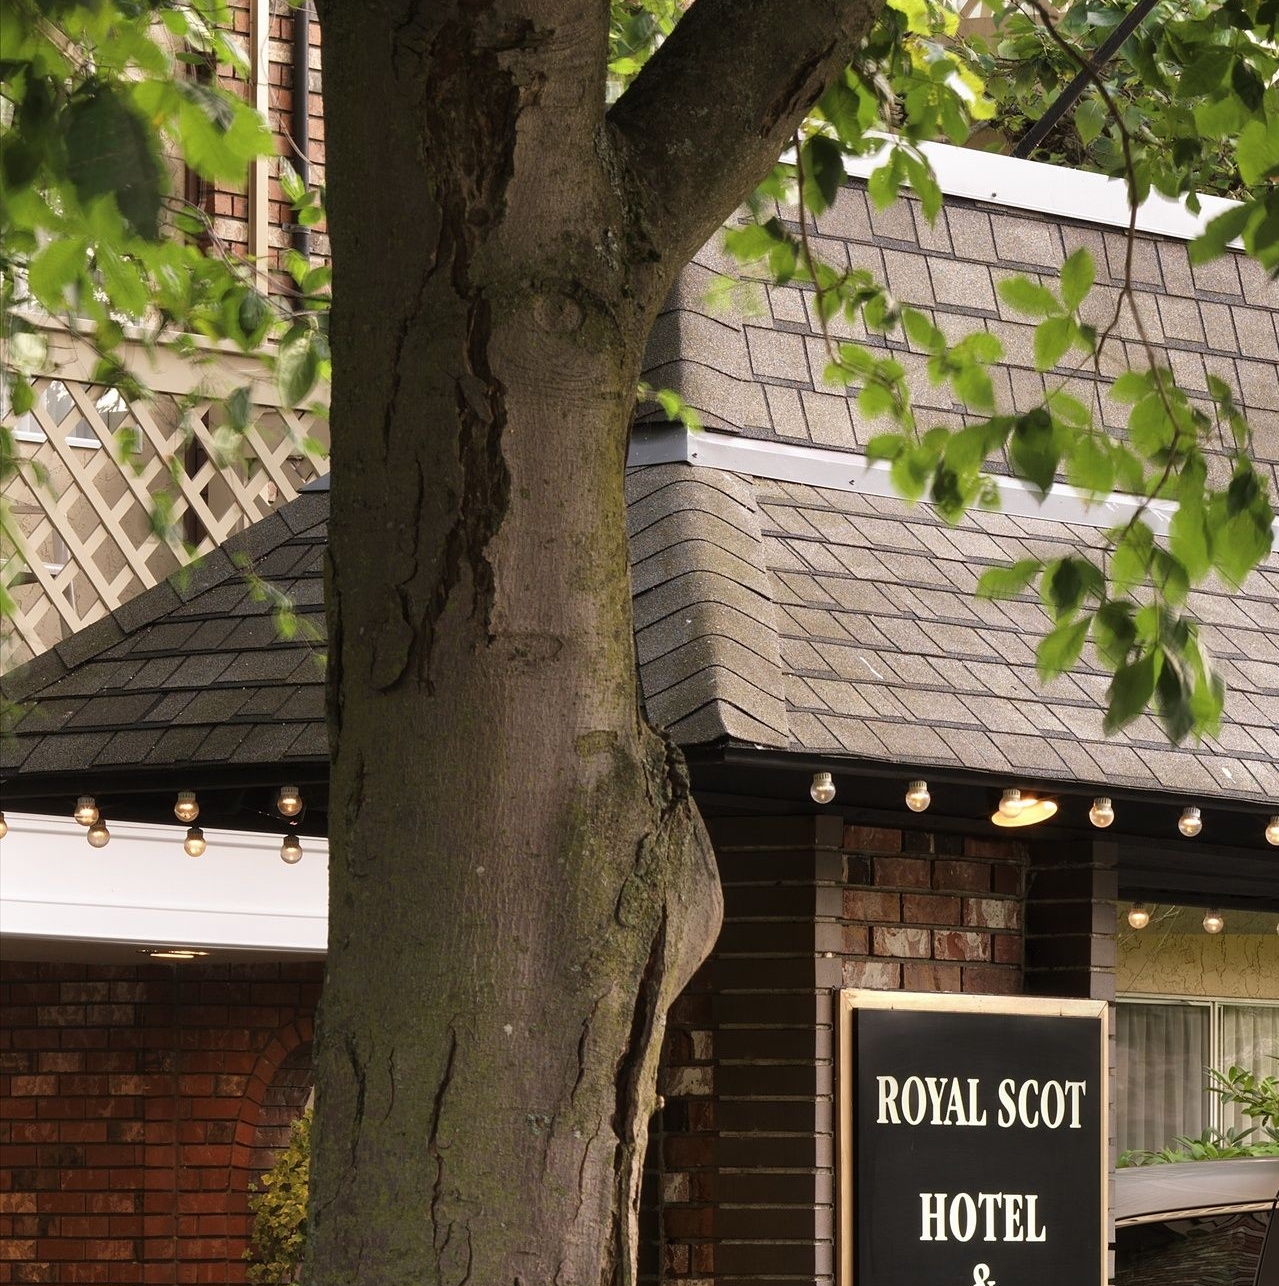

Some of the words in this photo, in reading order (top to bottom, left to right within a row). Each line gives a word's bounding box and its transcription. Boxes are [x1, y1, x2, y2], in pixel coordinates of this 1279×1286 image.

[875, 1075, 987, 1127] ROYAL
[997, 1078, 1087, 1129] SCOT
[918, 1191, 1047, 1243] HOTEL
